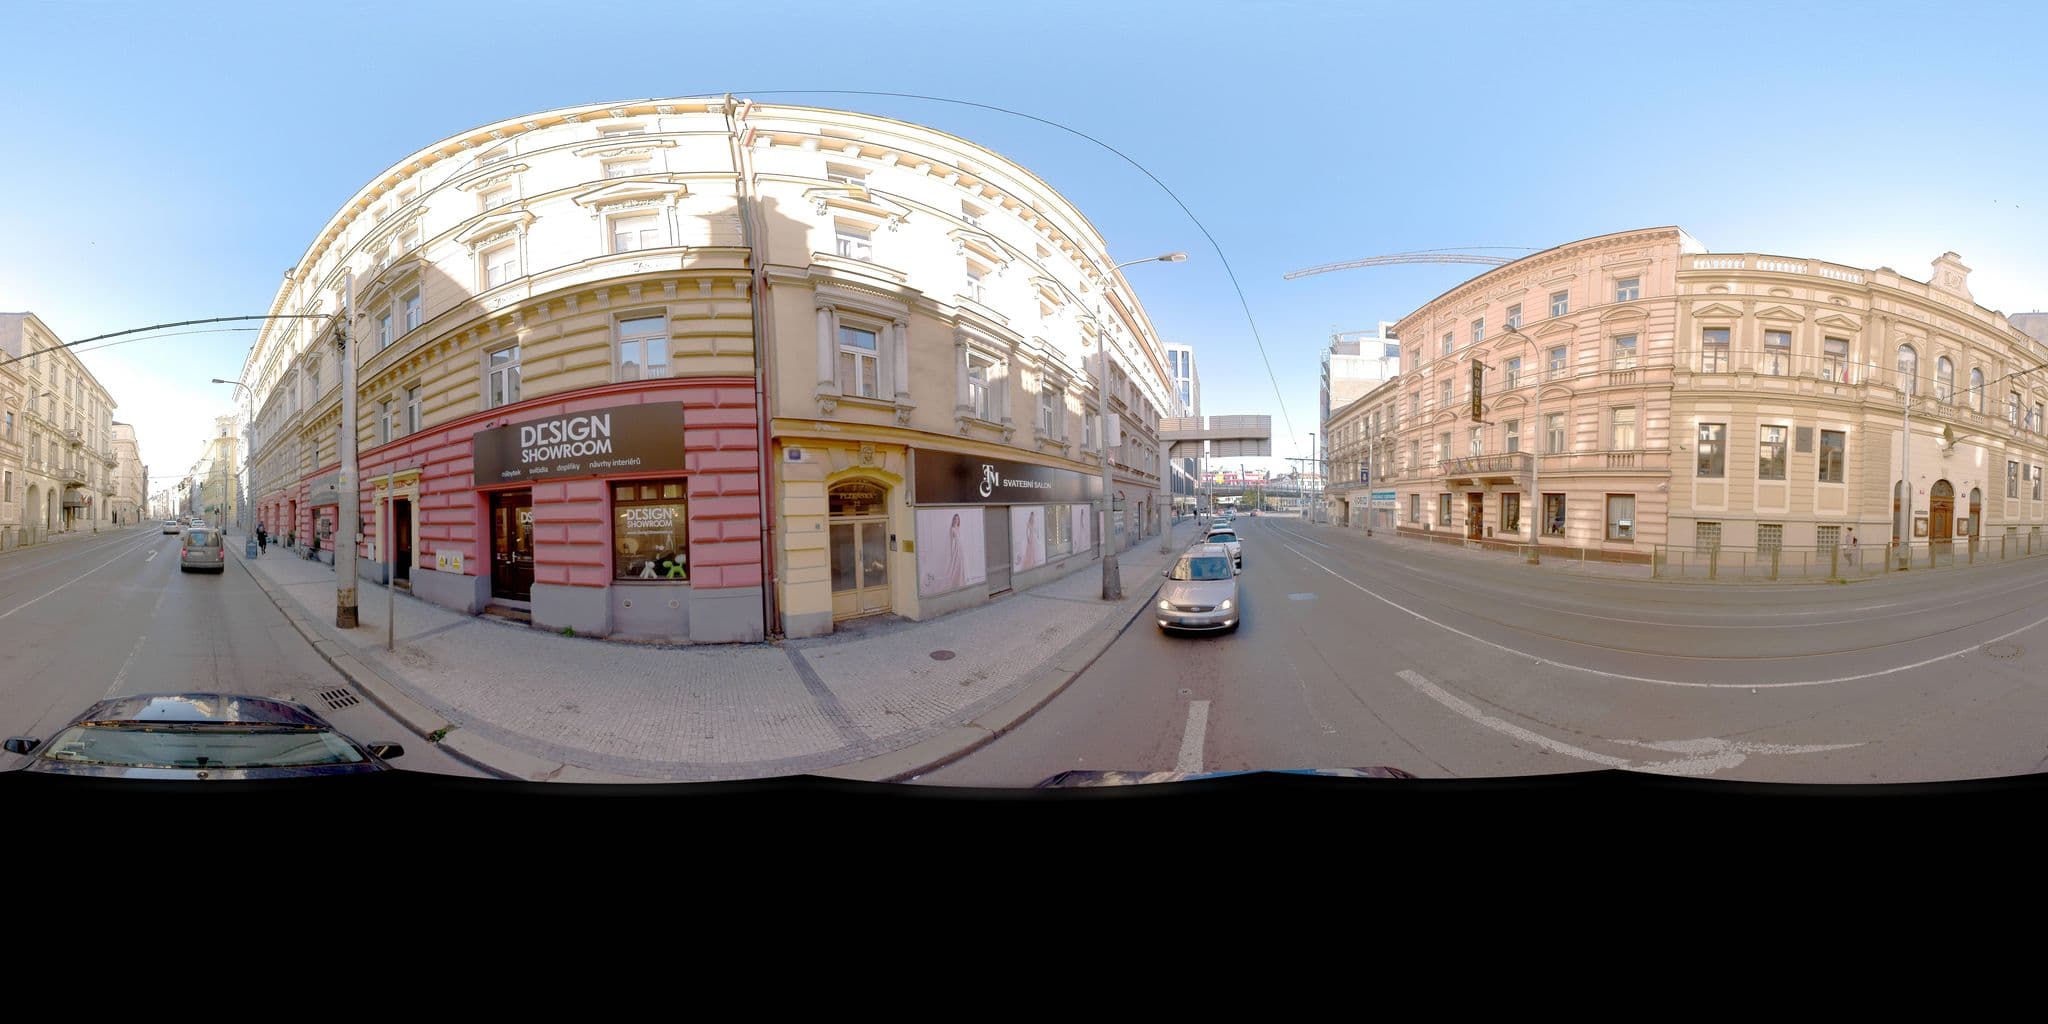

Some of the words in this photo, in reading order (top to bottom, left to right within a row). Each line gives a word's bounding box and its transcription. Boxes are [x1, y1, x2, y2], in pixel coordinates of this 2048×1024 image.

[521, 413, 611, 448] DESIGN
[521, 438, 613, 464] SHOWROOM
[589, 460, 611, 468] návrhy
[612, 457, 641, 466] interiérů
[1003, 479, 1033, 488] SVATEBNÍ
[1034, 481, 1052, 489] SALON
[626, 508, 672, 520] DESIGN
[626, 520, 672, 529] SHOWROOM
